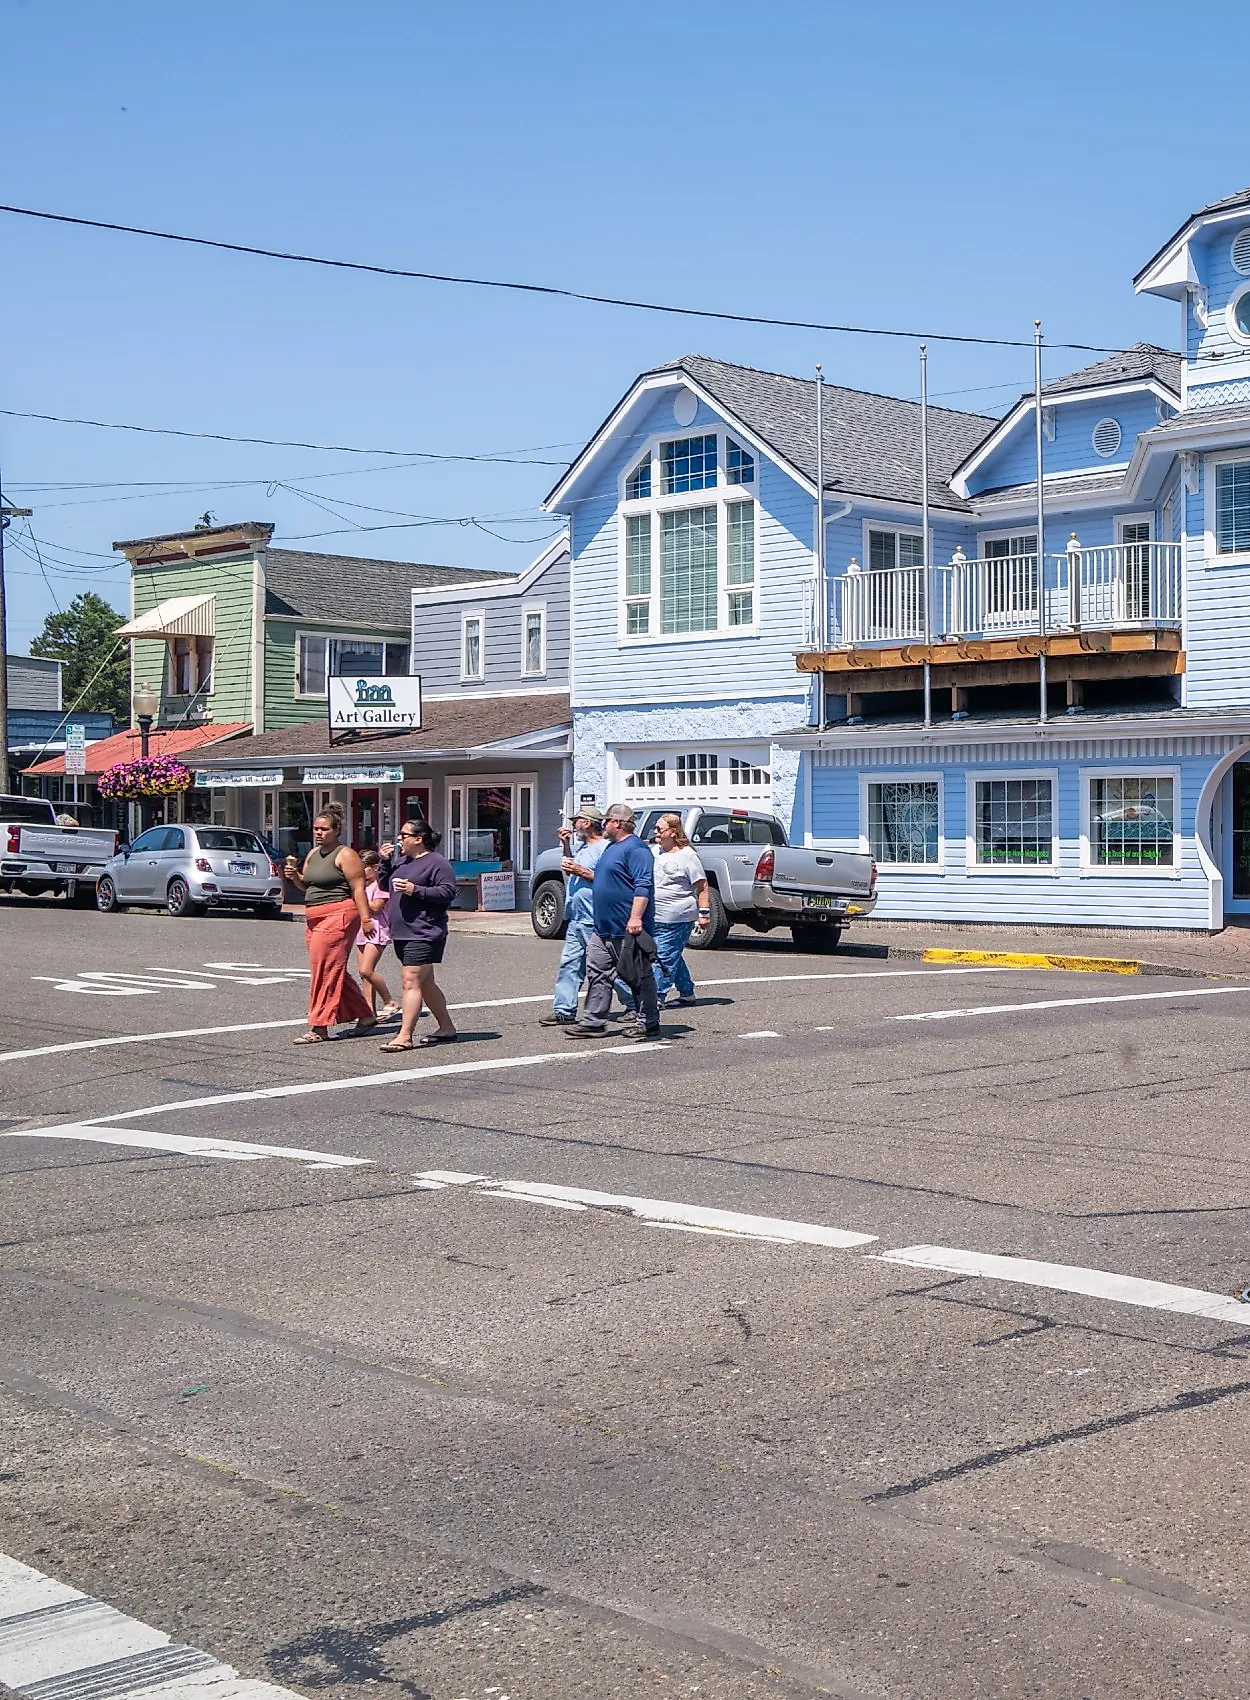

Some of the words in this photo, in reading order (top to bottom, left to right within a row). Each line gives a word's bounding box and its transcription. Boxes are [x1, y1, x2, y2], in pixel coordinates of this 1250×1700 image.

[334, 710, 359, 723] Art
[363, 709, 416, 727] Gallery
[27, 835, 113, 846] CHEVROLET
